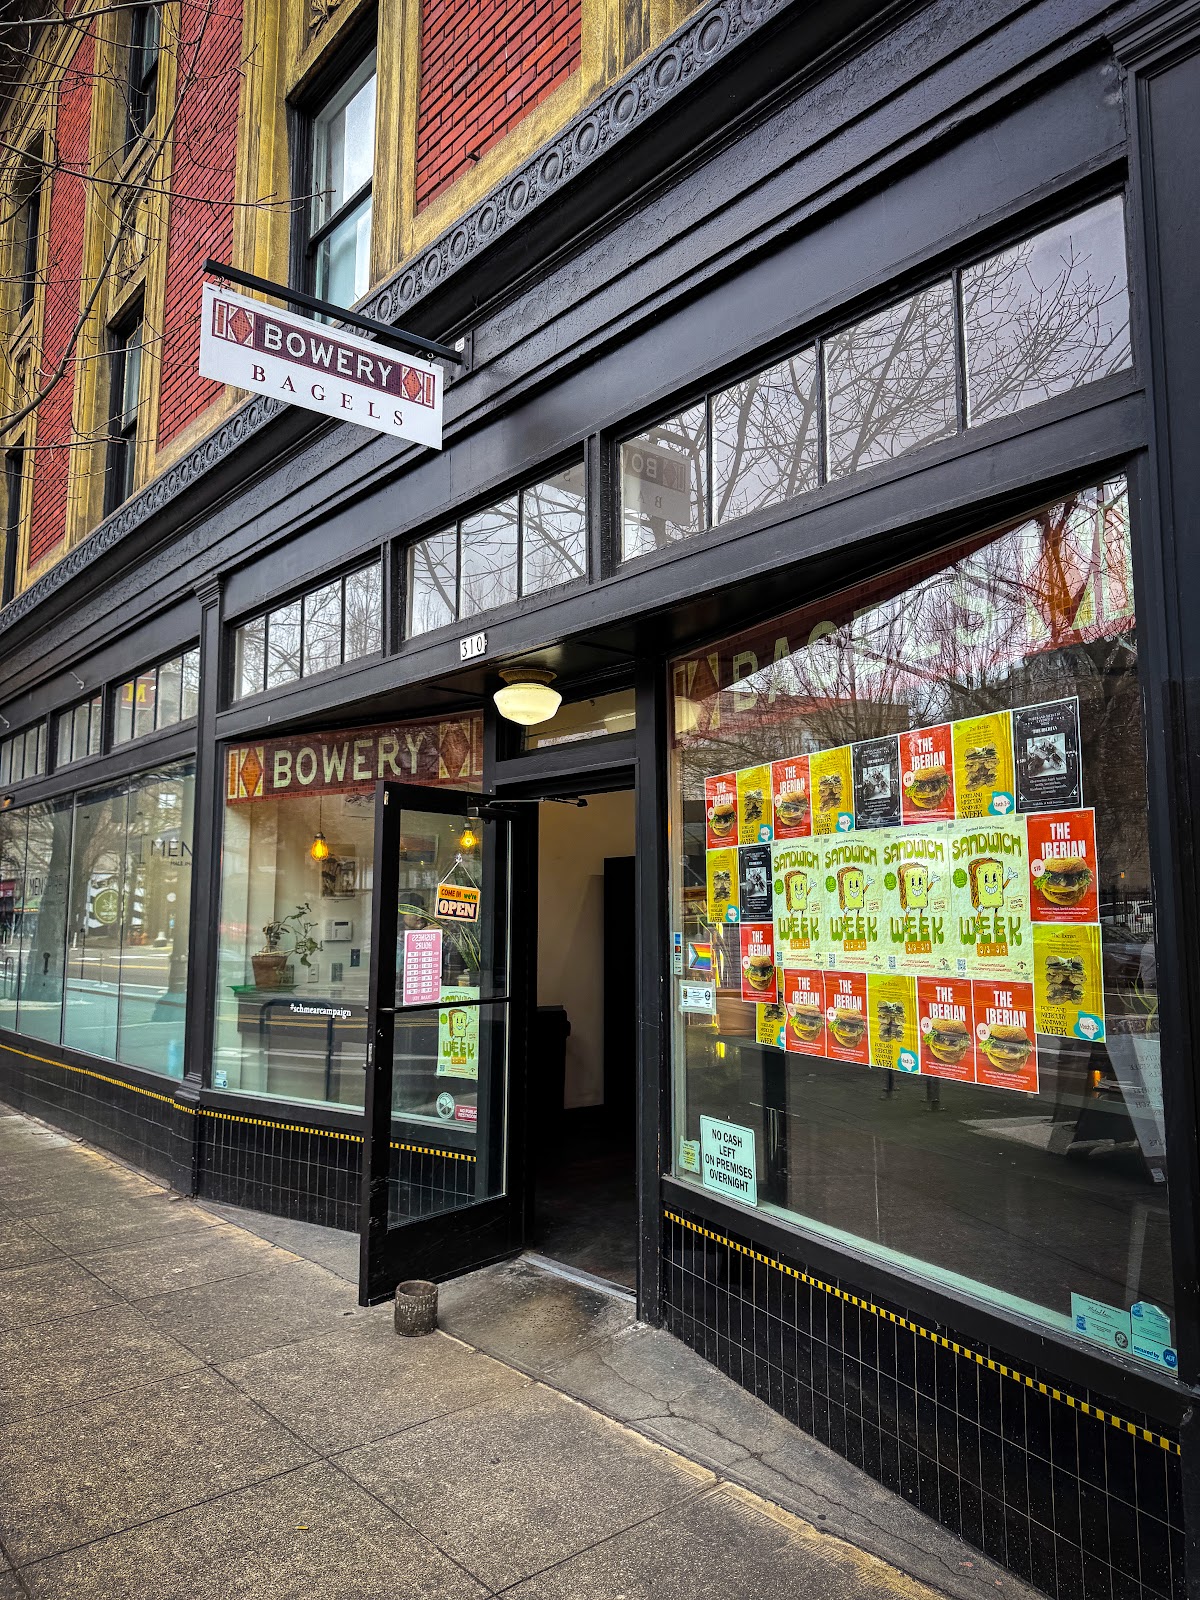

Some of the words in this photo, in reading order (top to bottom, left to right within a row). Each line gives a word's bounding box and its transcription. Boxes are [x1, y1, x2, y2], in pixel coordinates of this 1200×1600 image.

[264, 324, 392, 386] BOWERY
[251, 364, 403, 426] BAGELS
[461, 636, 483, 657] 310
[917, 737, 933, 753] THE
[273, 732, 427, 788] BOWERY
[911, 751, 946, 771] IBERIAN
[785, 765, 797, 780] THE
[716, 781, 726, 793] THE
[780, 777, 805, 793] IBERIAN
[712, 792, 734, 807] IBERIAN
[961, 810, 984, 819] WEEK
[1049, 822, 1071, 840] THE
[883, 839, 944, 865] SANDWICH
[952, 832, 1022, 861] SANDWICH
[1041, 840, 1087, 859] IBERIAN
[773, 851, 820, 873] SANDWICH
[824, 845, 877, 869] SANDWICH
[441, 888, 455, 897] COME
[439, 900, 475, 918] OPEN
[752, 930, 763, 943] THE
[778, 917, 820, 941] WEEK
[829, 917, 877, 942] WEEK
[890, 917, 944, 944] WEEK
[959, 917, 1022, 946] WEEK
[747, 944, 771, 957] IBERIAN
[797, 977, 811, 991] THE
[839, 980, 852, 994] THE
[792, 991, 819, 1006] IBERIAN
[833, 994, 862, 1010] IBERIAN
[935, 986, 953, 1003] THE
[993, 990, 1013, 1008] THE
[290, 1003, 352, 1019] #schmearcampaign
[929, 1003, 966, 1022] IBERIAN
[986, 1008, 1027, 1028] IBERIAN
[1041, 1025, 1067, 1036] WEEK
[442, 1041, 475, 1060] WEEK
[712, 1128, 721, 1141] NO
[724, 1132, 743, 1148] CASH
[719, 1145, 736, 1159] LEFT
[705, 1153, 715, 1167] ON
[716, 1157, 753, 1180] PREMISES
[709, 1168, 749, 1192] OVERNIGHT
